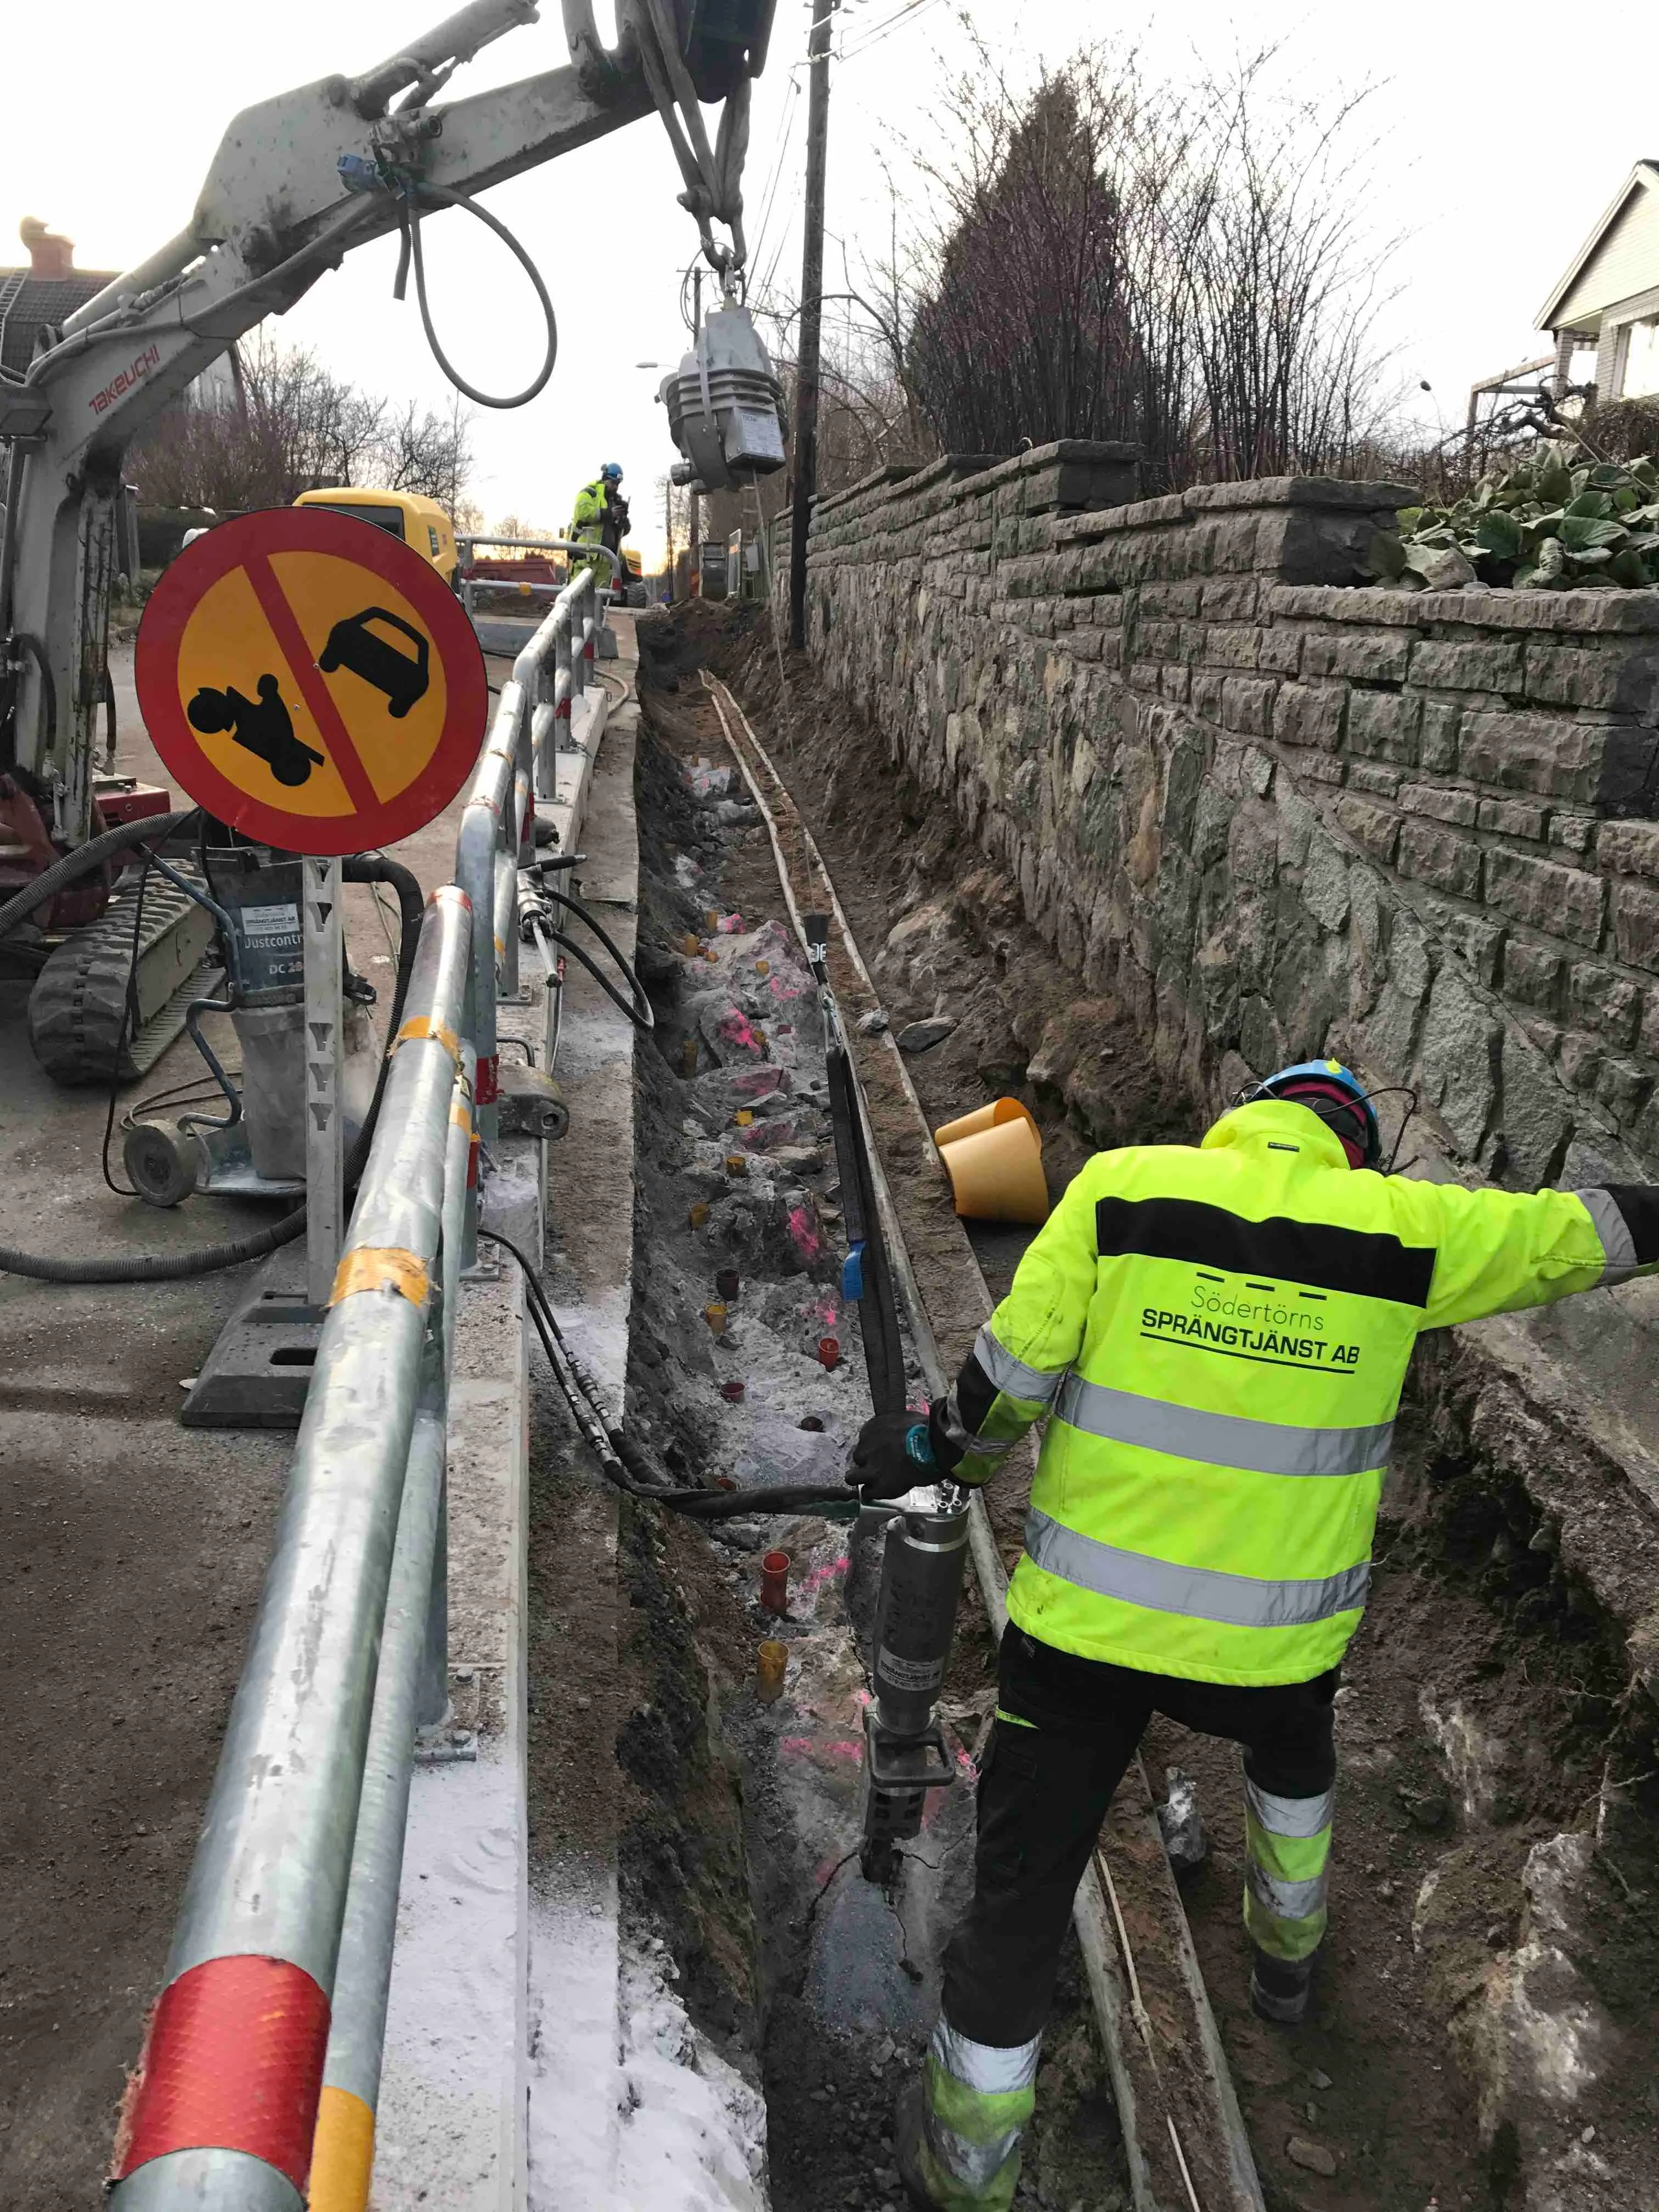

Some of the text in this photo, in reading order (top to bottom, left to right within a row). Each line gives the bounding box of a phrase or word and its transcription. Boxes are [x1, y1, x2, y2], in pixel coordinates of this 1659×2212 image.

[245, 934, 304, 949] Dustcontr
[268, 961, 304, 974] DC 28
[1190, 1285, 1324, 1331] Södertörns
[1141, 1308, 1361, 1364] SPRÄNGTJÄNST AB
